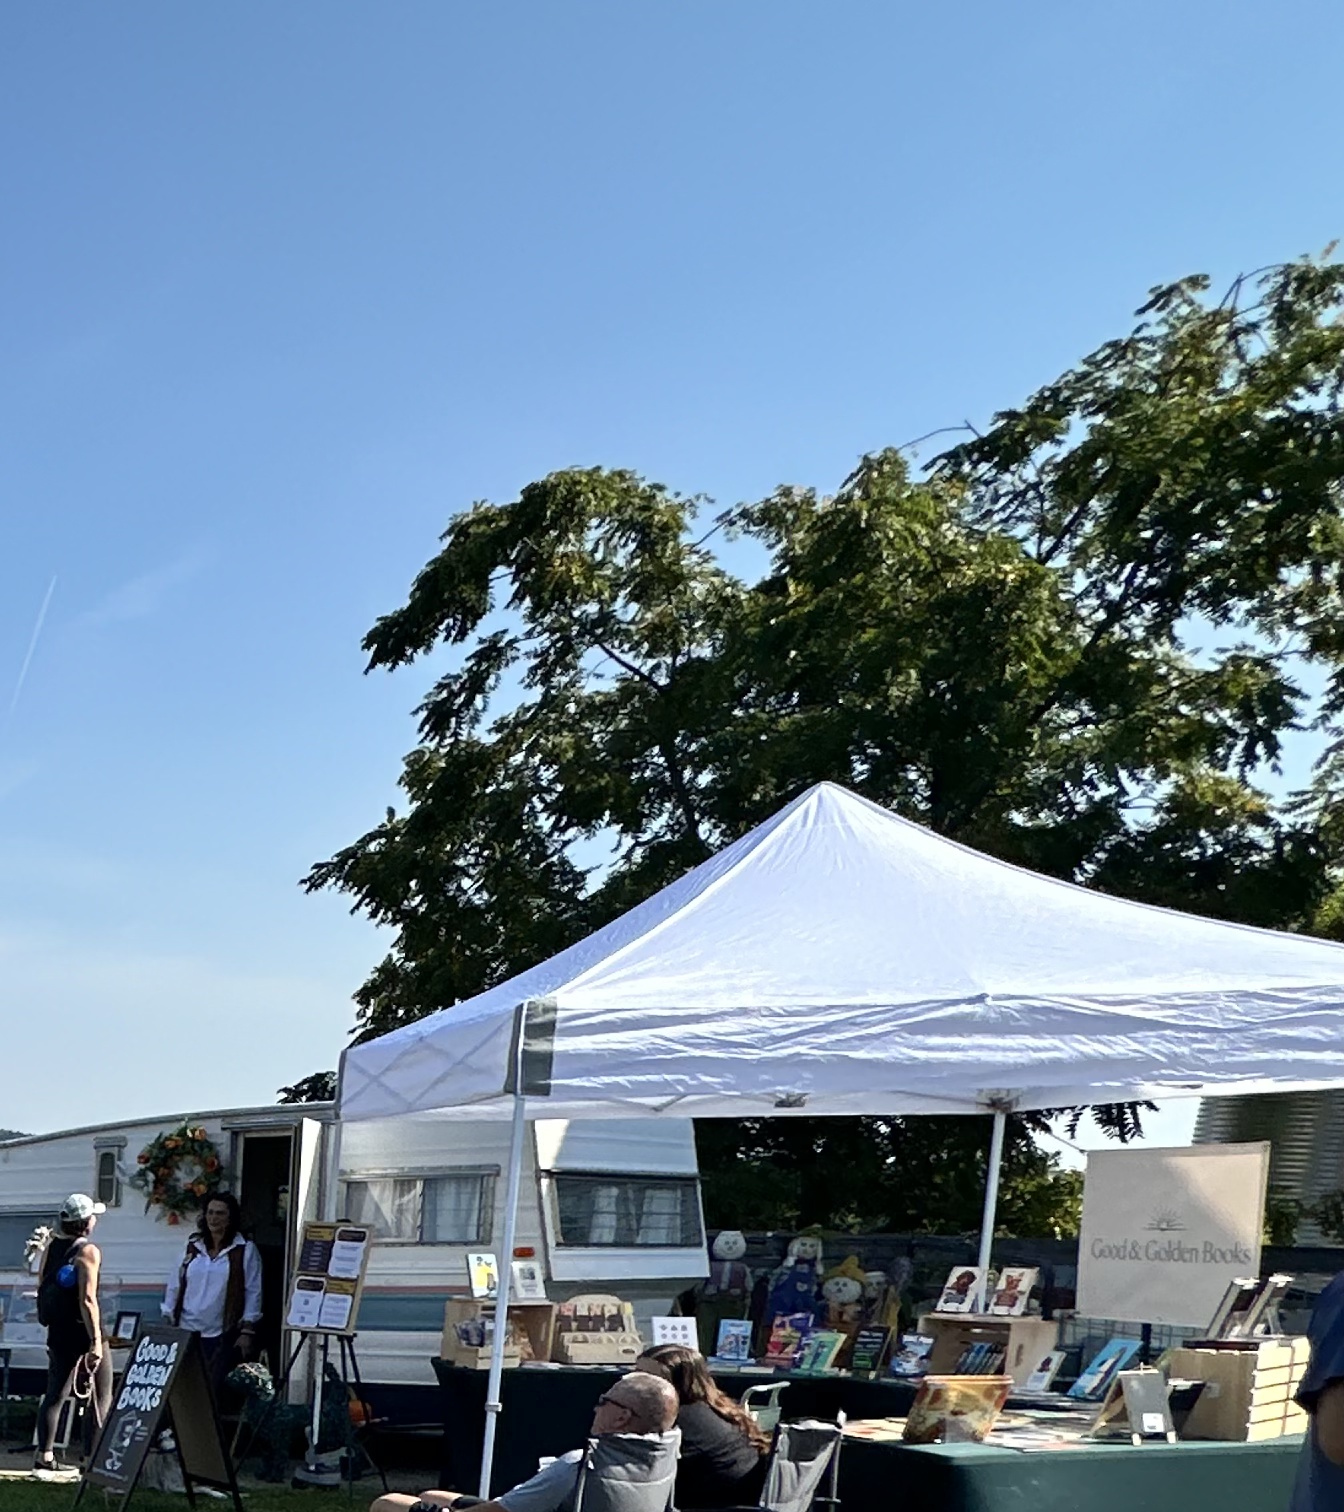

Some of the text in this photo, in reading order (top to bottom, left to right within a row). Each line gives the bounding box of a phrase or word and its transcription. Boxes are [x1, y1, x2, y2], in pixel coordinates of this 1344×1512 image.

[1090, 1238, 1251, 1264] Good & Golden Books
[166, 1342, 178, 1364] &
[116, 1386, 162, 1412] BOOKS
